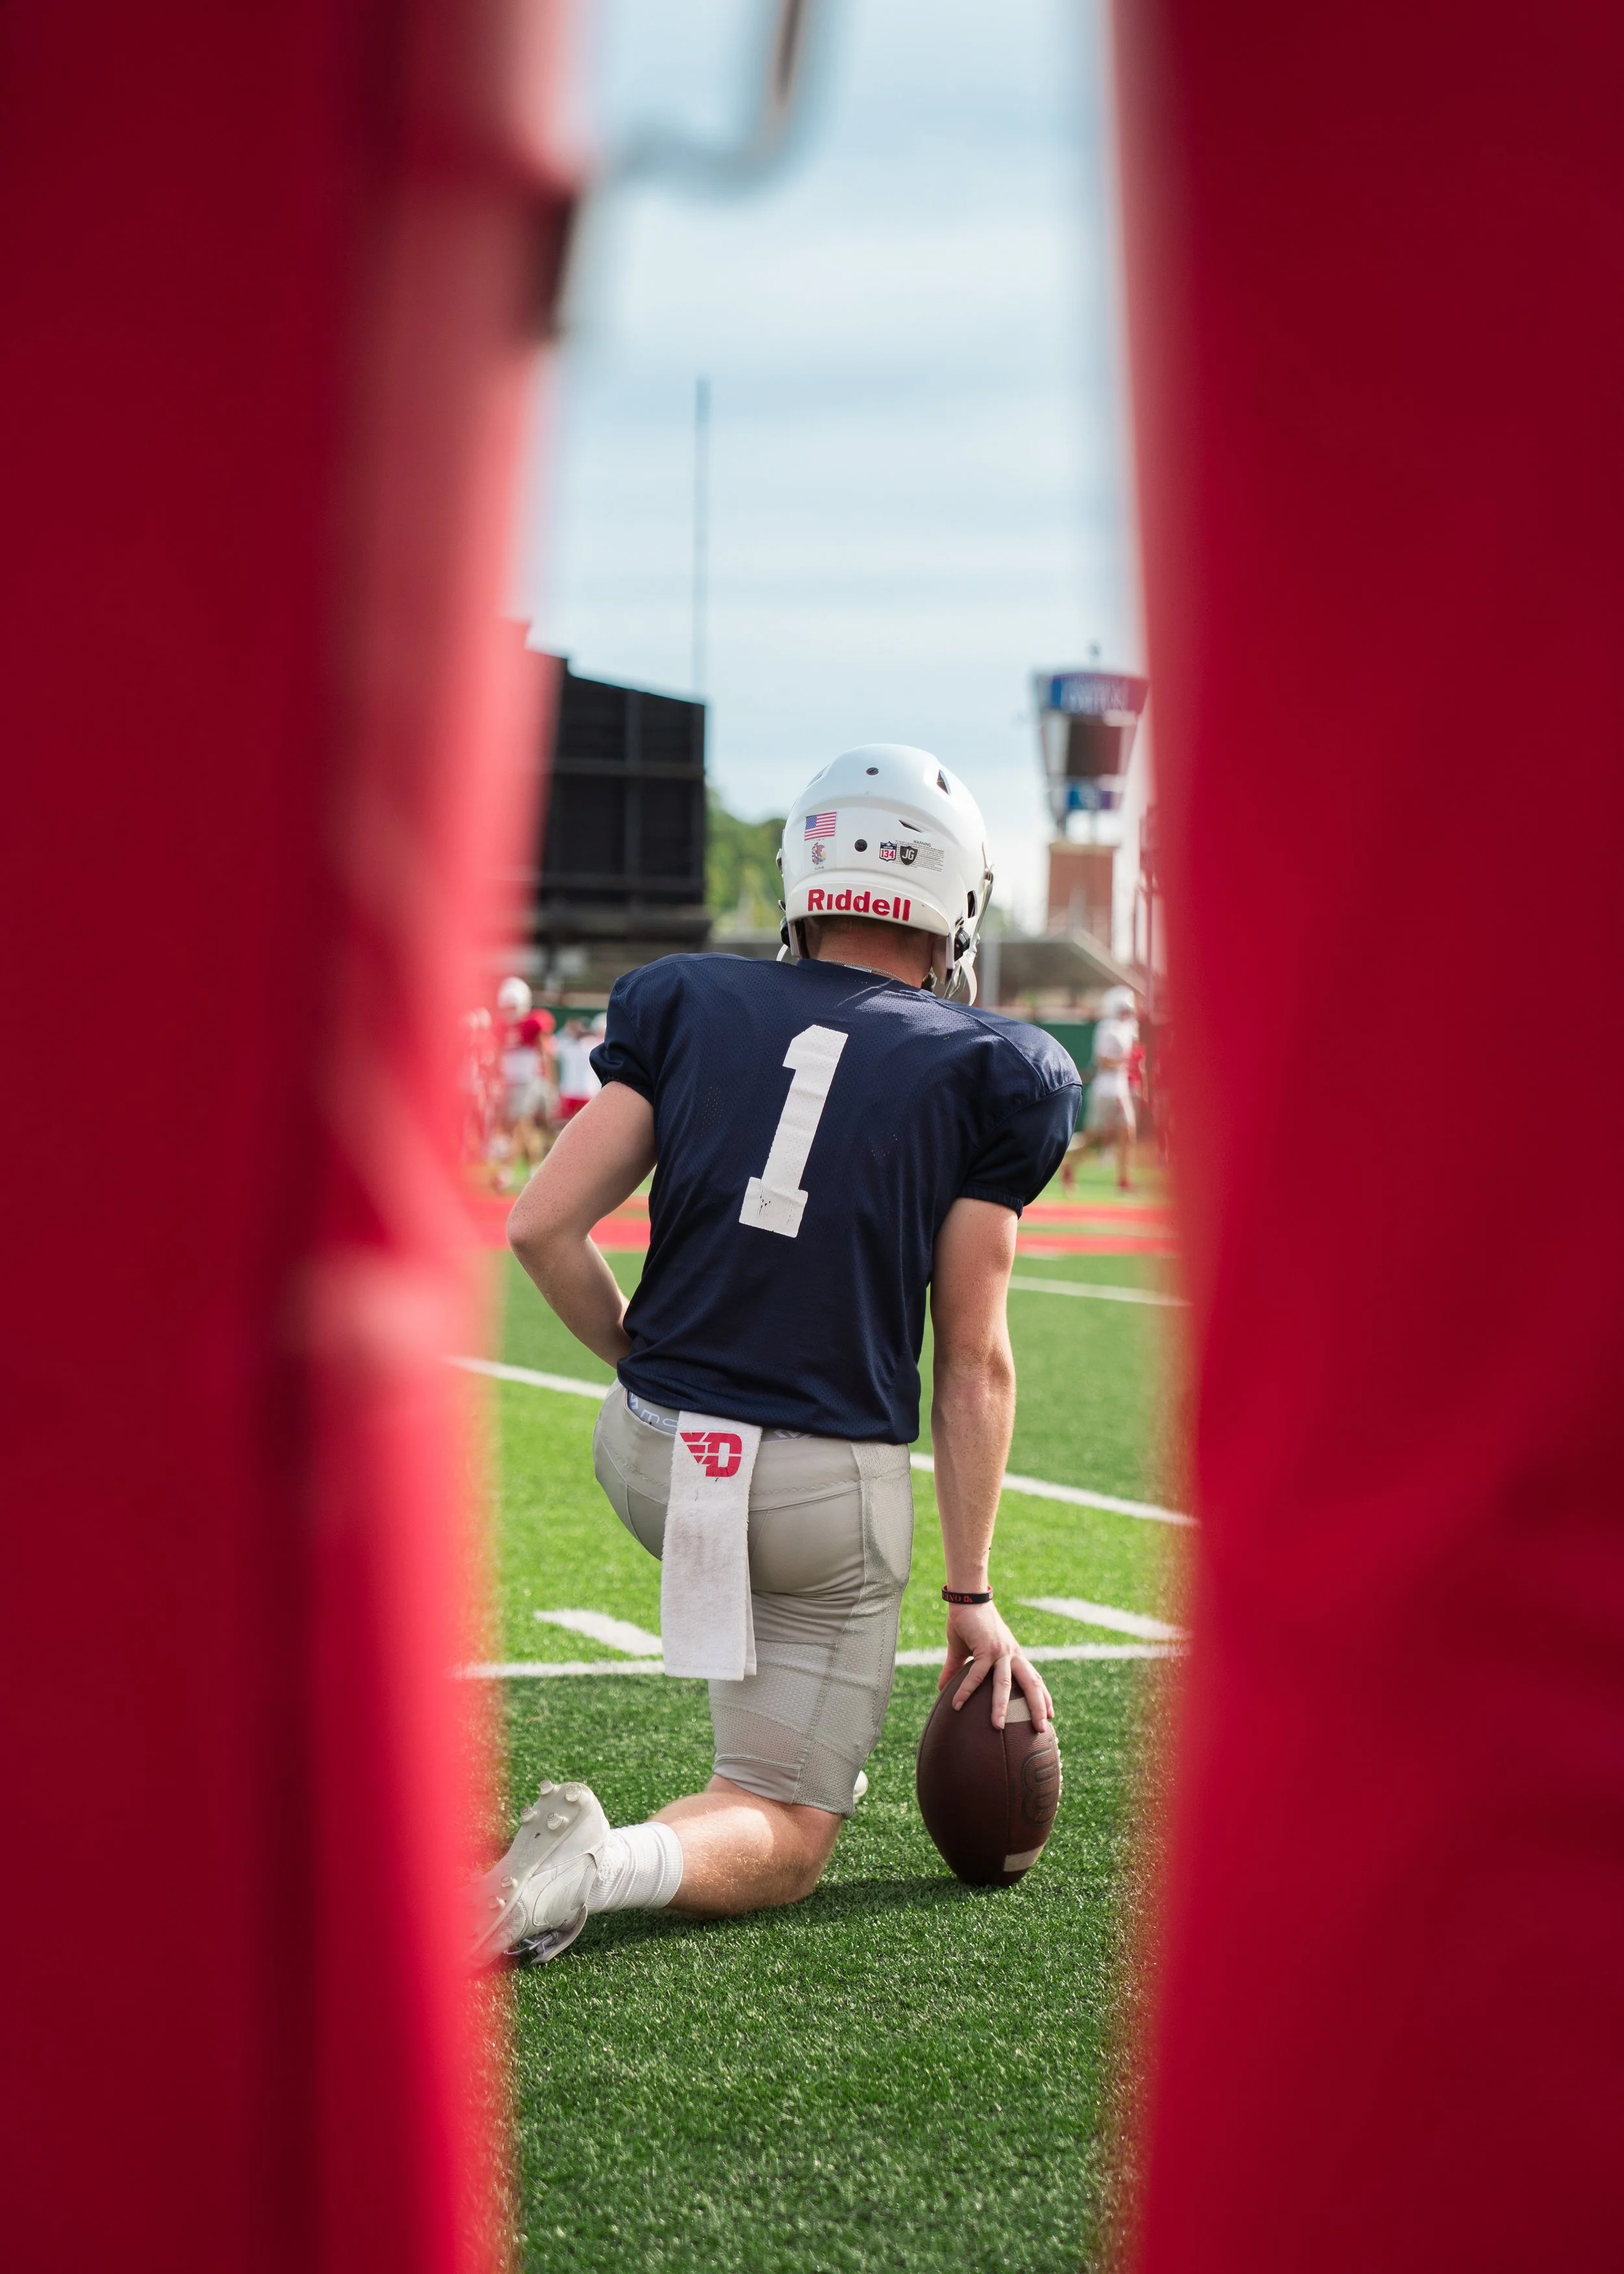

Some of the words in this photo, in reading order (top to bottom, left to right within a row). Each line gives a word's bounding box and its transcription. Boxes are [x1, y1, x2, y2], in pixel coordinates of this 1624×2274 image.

[881, 850, 894, 858] 134
[902, 849, 915, 860] JG
[807, 889, 911, 921] Riddell
[739, 1024, 848, 1238] 1
